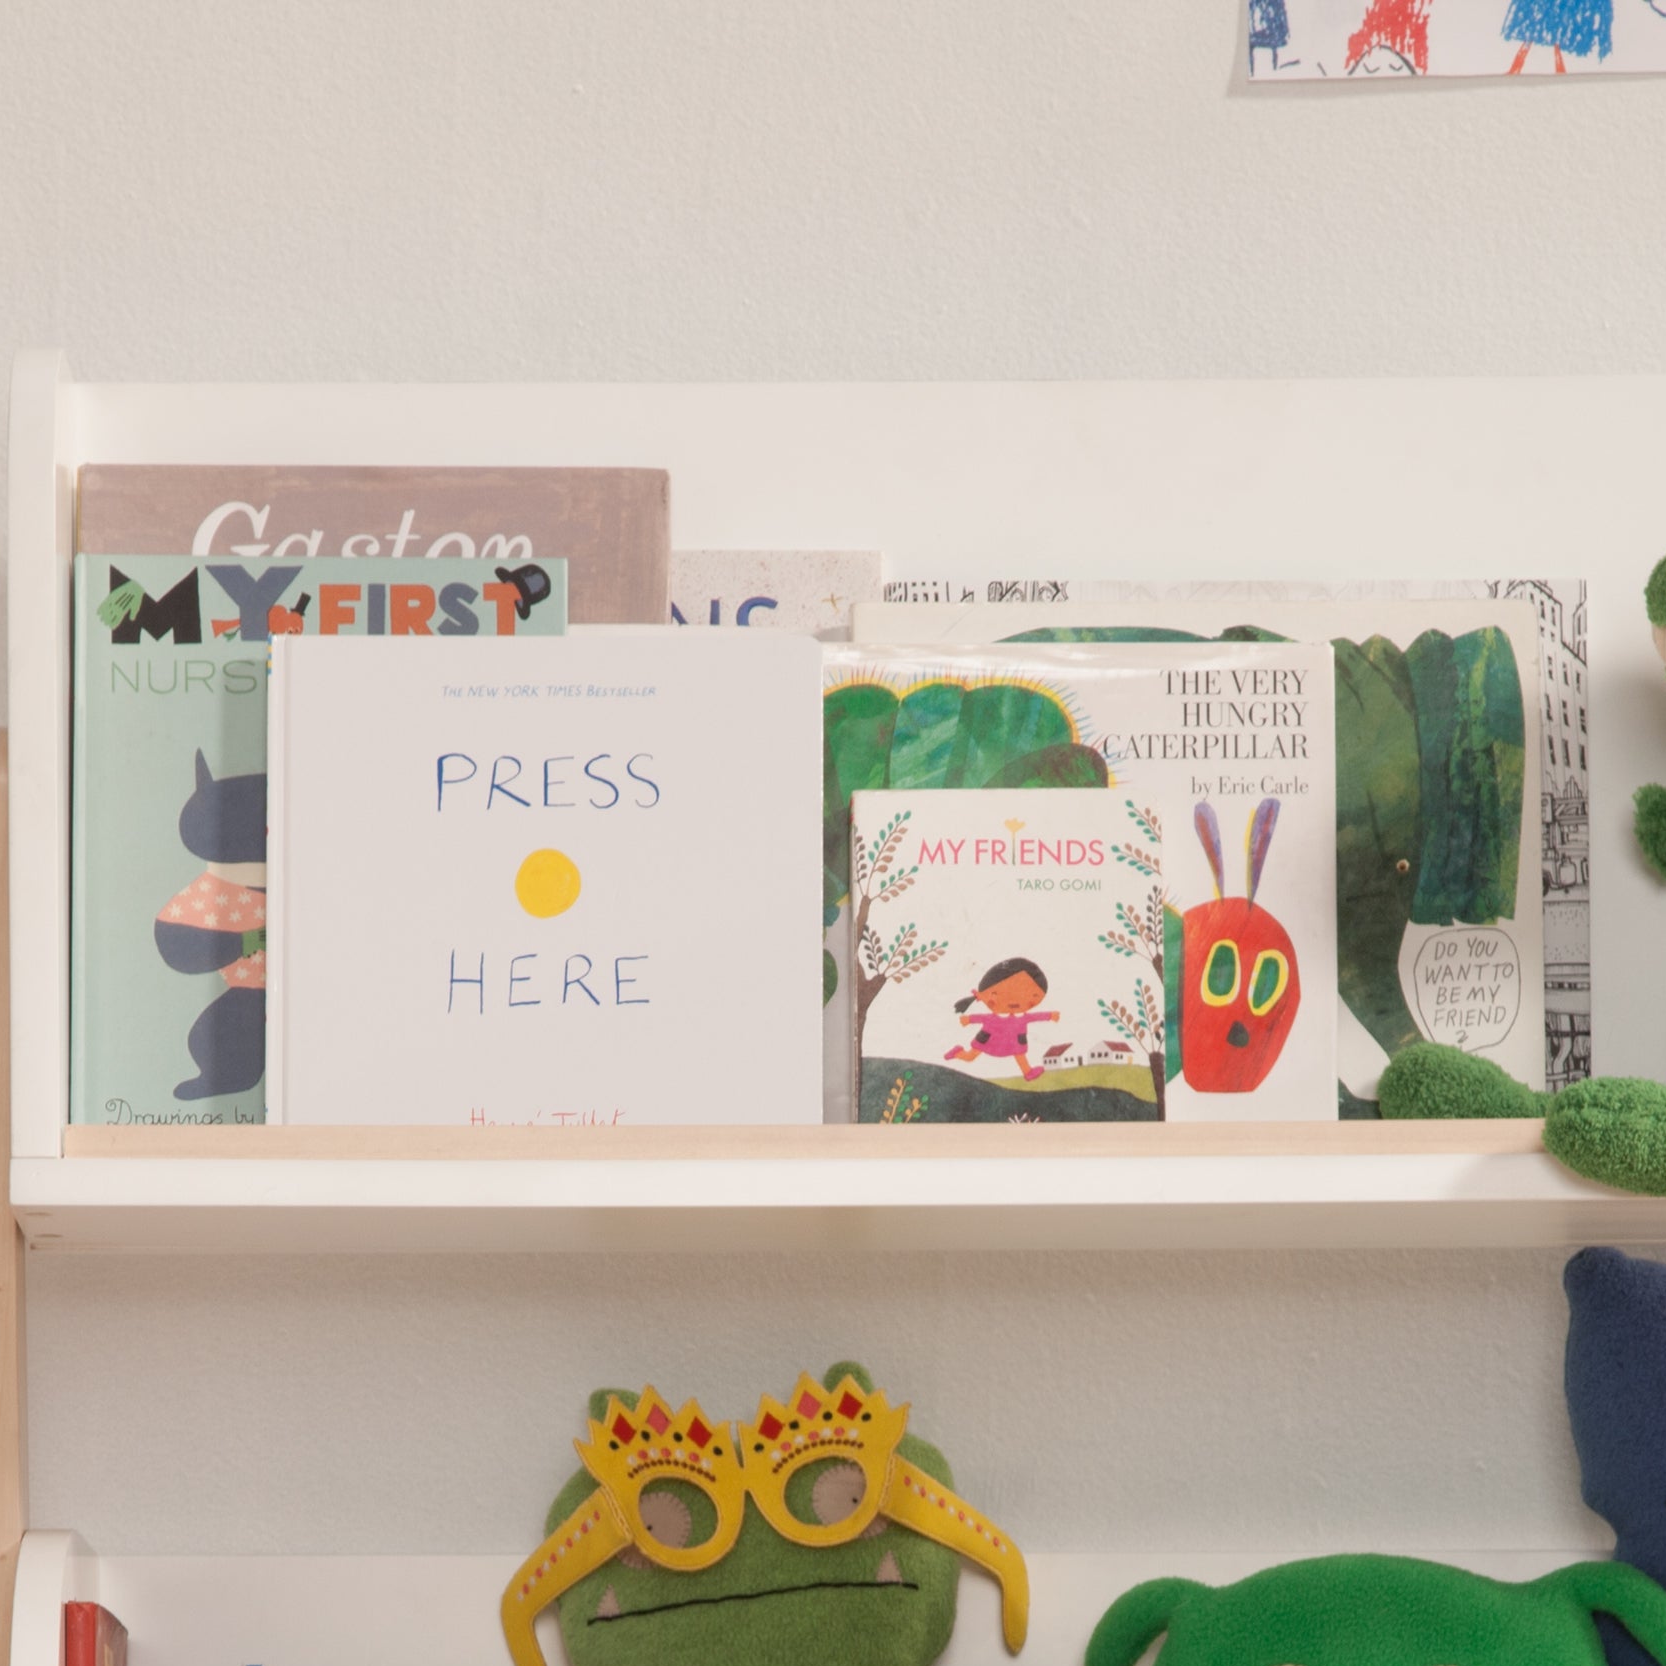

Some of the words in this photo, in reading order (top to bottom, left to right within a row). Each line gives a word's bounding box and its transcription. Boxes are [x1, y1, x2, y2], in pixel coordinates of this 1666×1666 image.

[110, 565, 304, 645] MY
[319, 583, 523, 637] FIRST
[111, 660, 269, 695] NURS
[1159, 668, 1222, 696] THE
[1231, 668, 1309, 696] VERY
[442, 685, 463, 698] THE
[467, 685, 499, 698] NEW
[503, 685, 541, 698] YORK
[546, 685, 582, 698] TIMES
[586, 685, 657, 698] BESTSELLER
[1181, 701, 1309, 728] HUNGRY
[1103, 733, 1310, 760] CATERPILLAR
[437, 752, 660, 812] PRESS
[1191, 775, 1212, 800] by
[1218, 775, 1255, 795] Eric
[1260, 775, 1309, 795] Carle
[917, 838, 965, 866] MY
[974, 837, 1105, 866] FRIENDS
[1017, 878, 1054, 891] TARO
[1060, 878, 1102, 891] GOMI
[1434, 940, 1458, 961] DO
[1467, 936, 1499, 958] YOU
[448, 950, 651, 1014] HERE
[1425, 962, 1490, 985] WANT
[1491, 961, 1515, 981] TO
[1436, 985, 1462, 1005] BE
[1466, 984, 1501, 1004] MY
[1434, 1005, 1507, 1027] FRIEND
